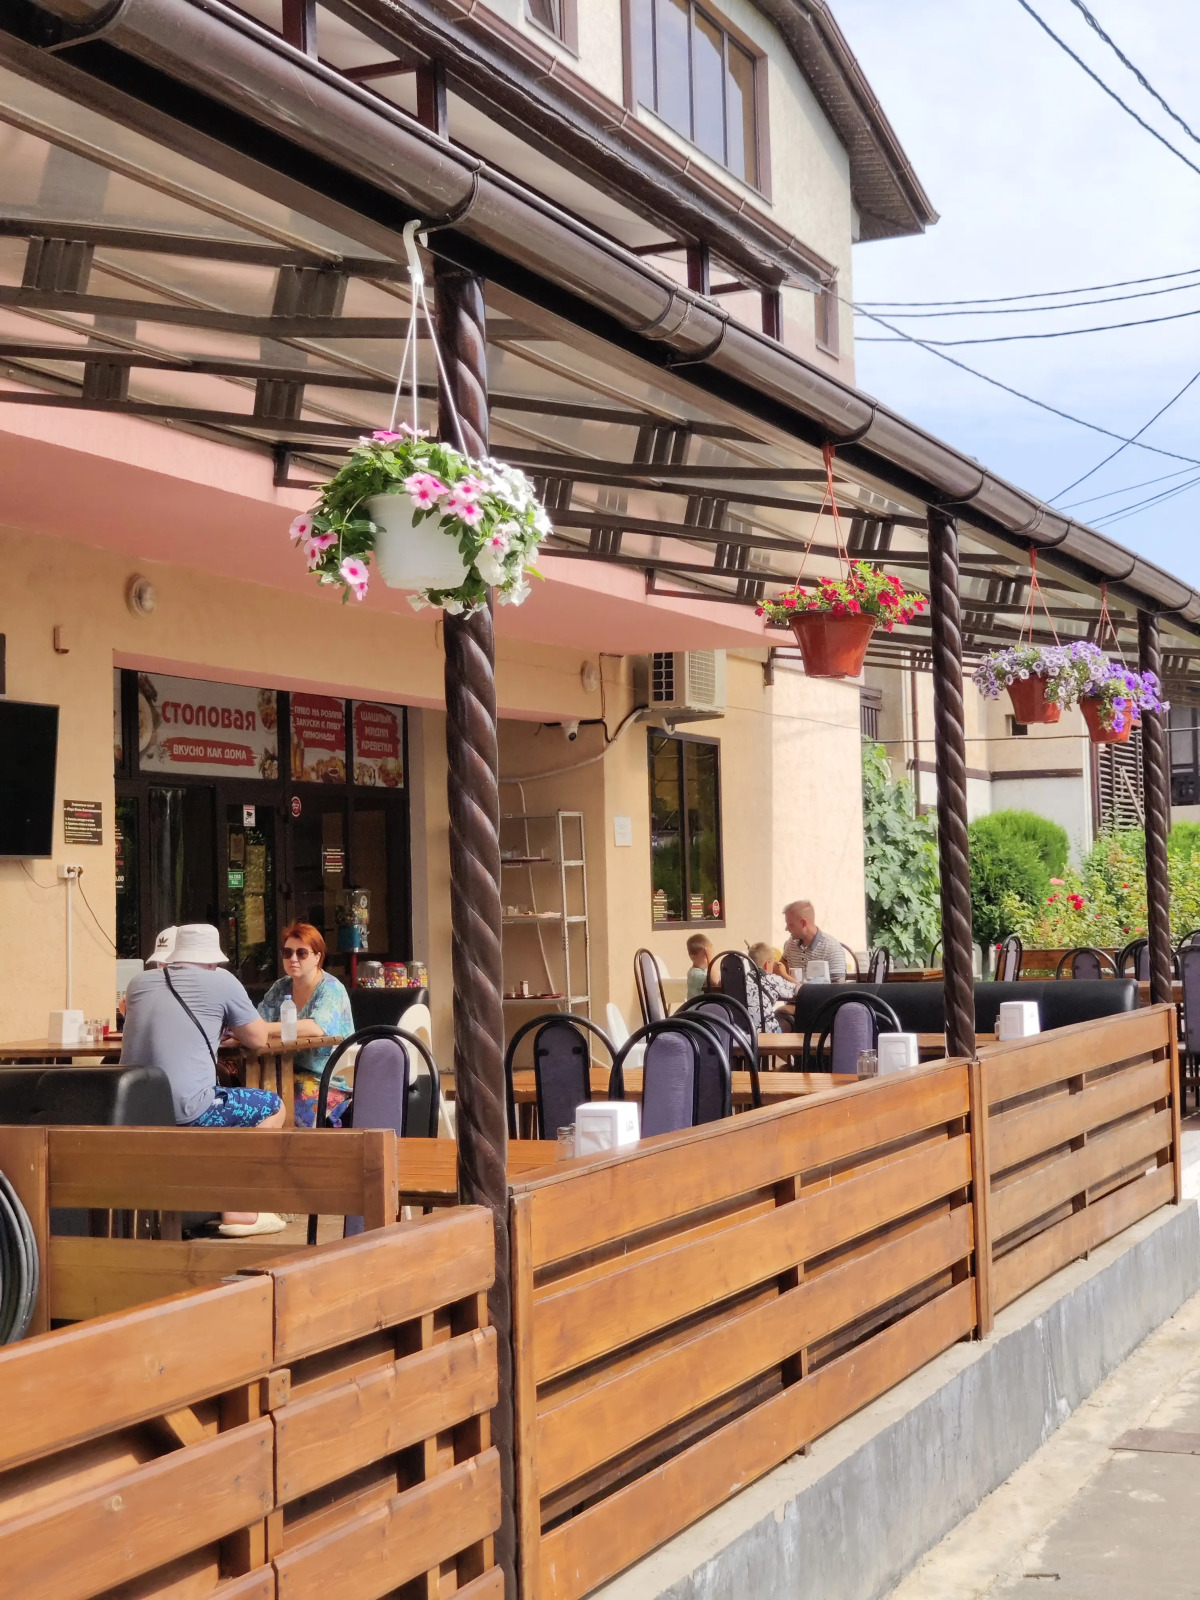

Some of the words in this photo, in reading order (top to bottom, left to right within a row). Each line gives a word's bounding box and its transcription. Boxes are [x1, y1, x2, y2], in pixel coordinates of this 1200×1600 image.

[321, 710, 342, 718] РОЗЛИВ
[360, 711, 392, 723] ШАШЛЫК
[296, 718, 319, 727] ЗАКУСКИ
[303, 731, 335, 741] ЛИМОНАДЫ
[365, 726, 388, 737] МИДИИ
[174, 744, 204, 756] ВКУСНО
[207, 747, 222, 757] КАК
[224, 749, 247, 760] ДОМА
[362, 741, 392, 752] КРЕВЕТКИ
